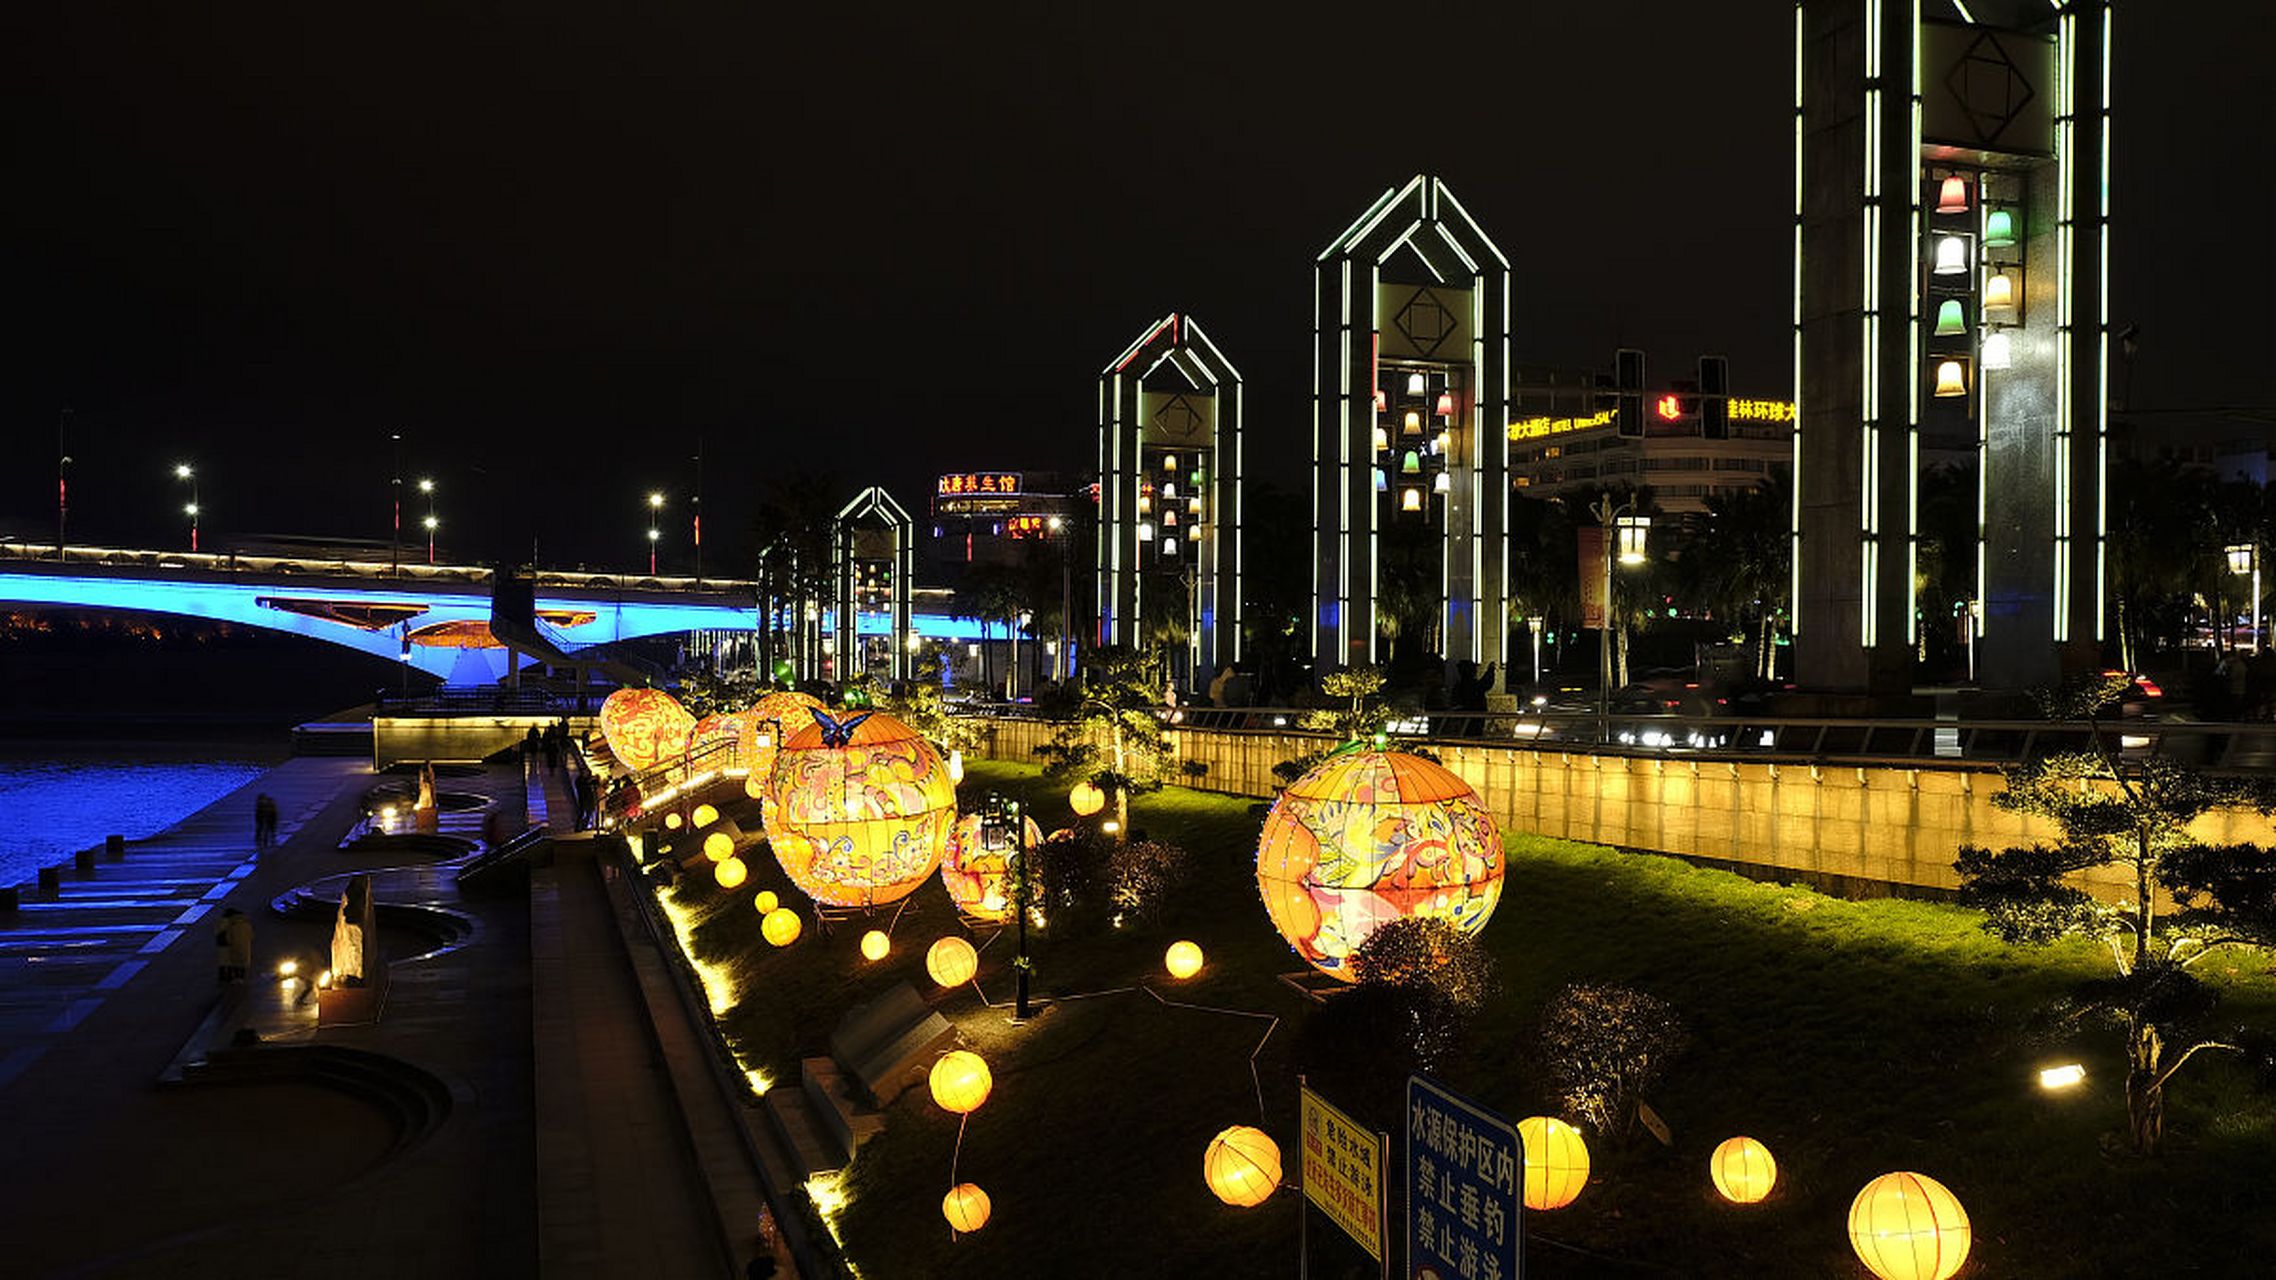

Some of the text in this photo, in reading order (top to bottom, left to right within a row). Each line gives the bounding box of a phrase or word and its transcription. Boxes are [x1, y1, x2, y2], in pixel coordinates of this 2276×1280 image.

[1326, 1144, 1374, 1198] 禁止游泳
[1412, 1098, 1514, 1196] 水源保护区内
[1418, 1154, 1505, 1246] 禁止垂钓
[1418, 1205, 1502, 1280] 禁止游泳
